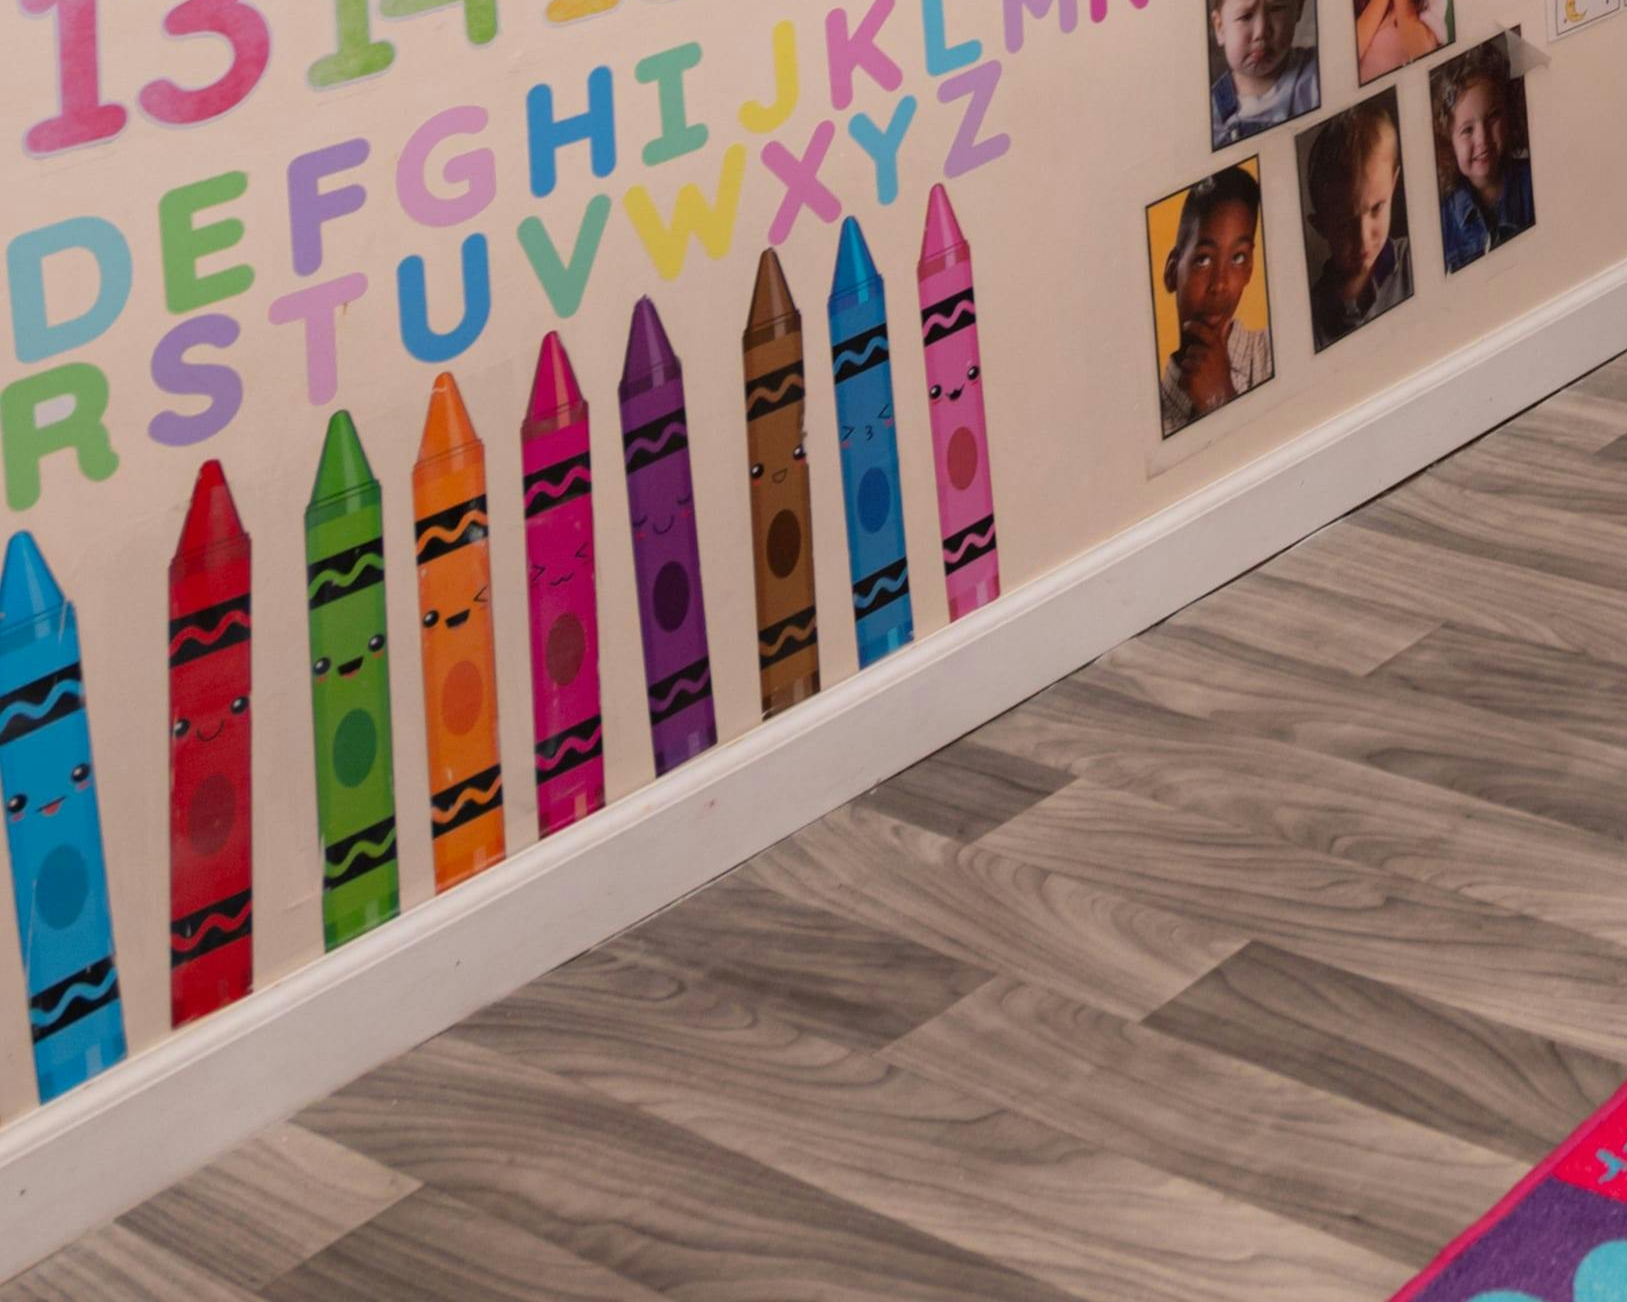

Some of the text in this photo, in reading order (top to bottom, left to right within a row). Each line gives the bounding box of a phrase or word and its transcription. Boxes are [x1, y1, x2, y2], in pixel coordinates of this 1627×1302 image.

[0, 59, 1010, 513] R S T U V W X Y Z
[6, 216, 133, 364] D
[158, 170, 255, 315] E
[286, 137, 371, 277] F
[396, 105, 497, 227] G
[526, 65, 617, 198] H
[635, 42, 709, 166] I
[738, 20, 799, 133] J
